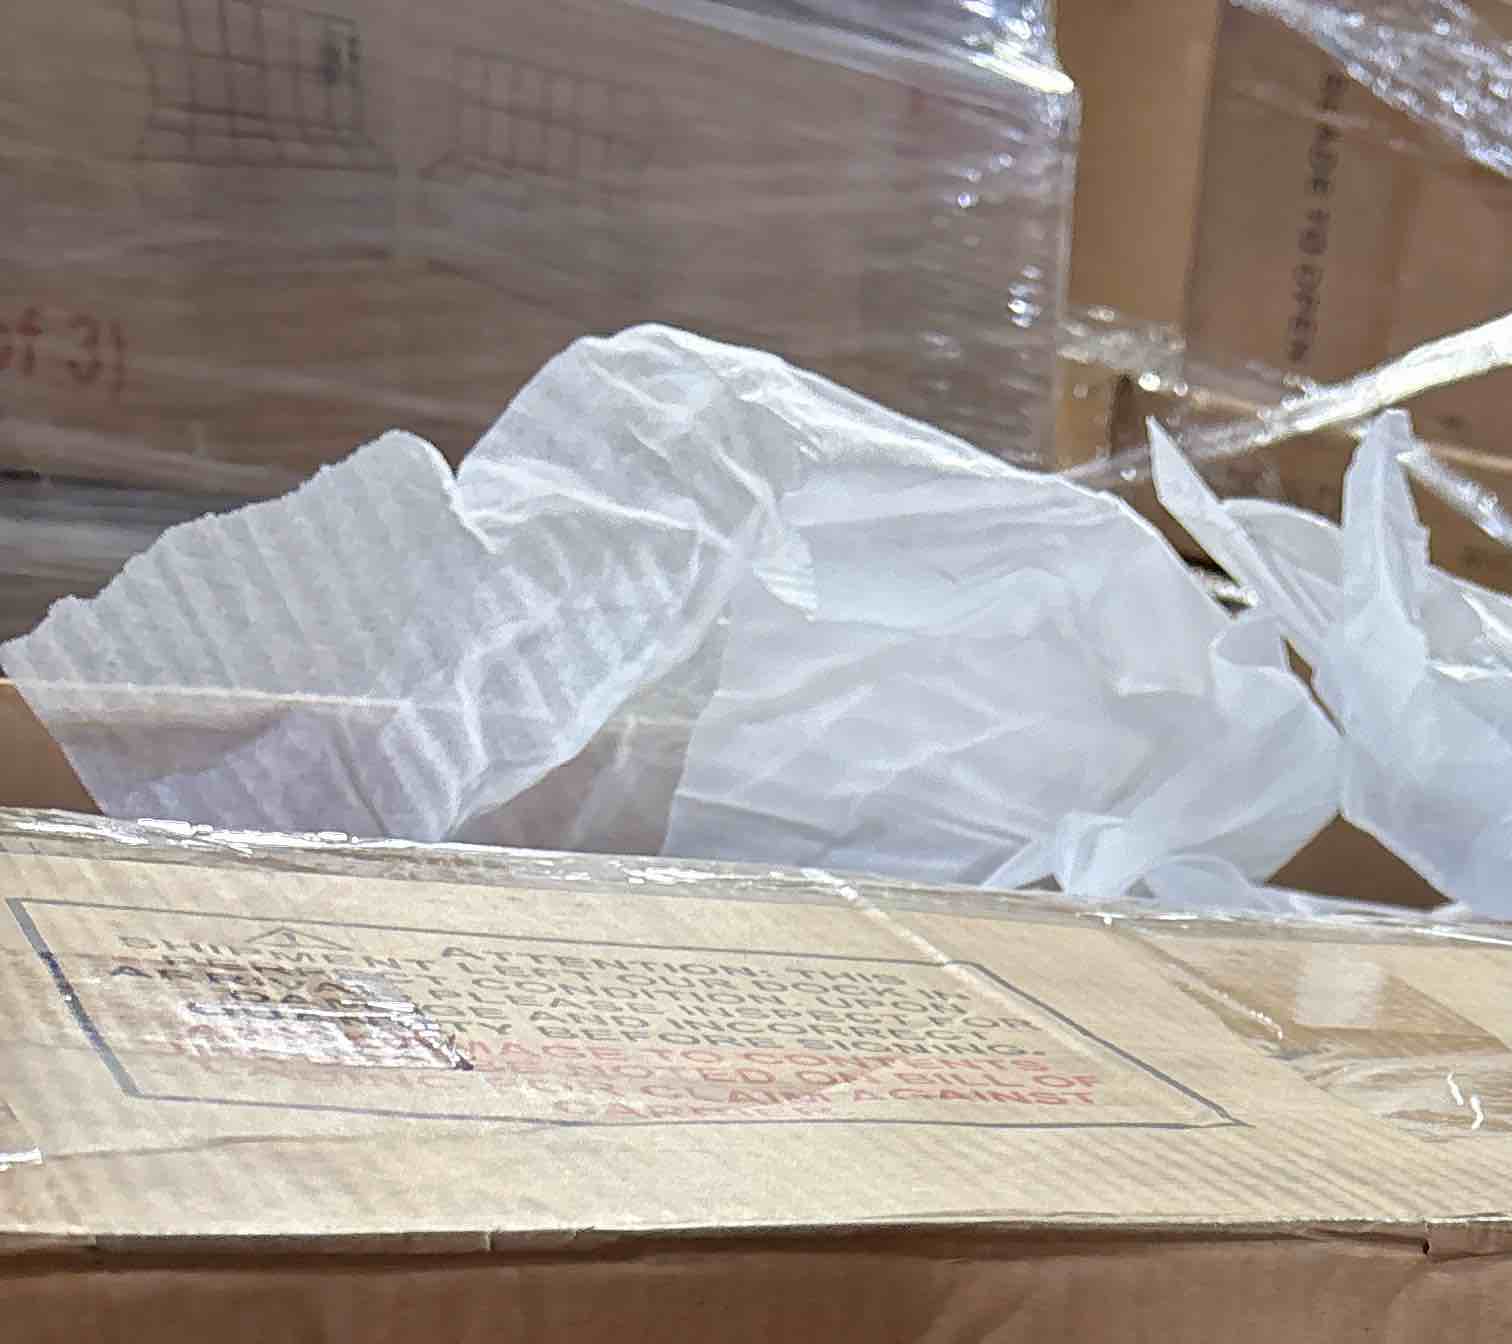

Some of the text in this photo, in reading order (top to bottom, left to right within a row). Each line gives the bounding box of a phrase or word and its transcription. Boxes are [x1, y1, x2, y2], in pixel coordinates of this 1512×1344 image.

[119, 936, 436, 970] SHIPMENT
[457, 962, 592, 981] LEFT
[616, 974, 737, 990] OUR
[753, 980, 904, 997] DOCK
[443, 946, 907, 985] ATTENTION: THIS
[428, 989, 662, 1014] PLEASE
[678, 1004, 908, 1026] INSPECT
[929, 1016, 1042, 1031] FOR
[817, 997, 967, 1014] UPON
[530, 1011, 648, 1028] AND
[667, 1017, 988, 1040] INCORRECT
[537, 1026, 784, 1048] BEFORE
[798, 1039, 1046, 1056] SIGNING.
[638, 1049, 722, 1063] TO
[739, 1052, 1050, 1071] CONTENTS
[894, 1073, 1023, 1087] BILL
[1032, 1074, 1100, 1088] OF
